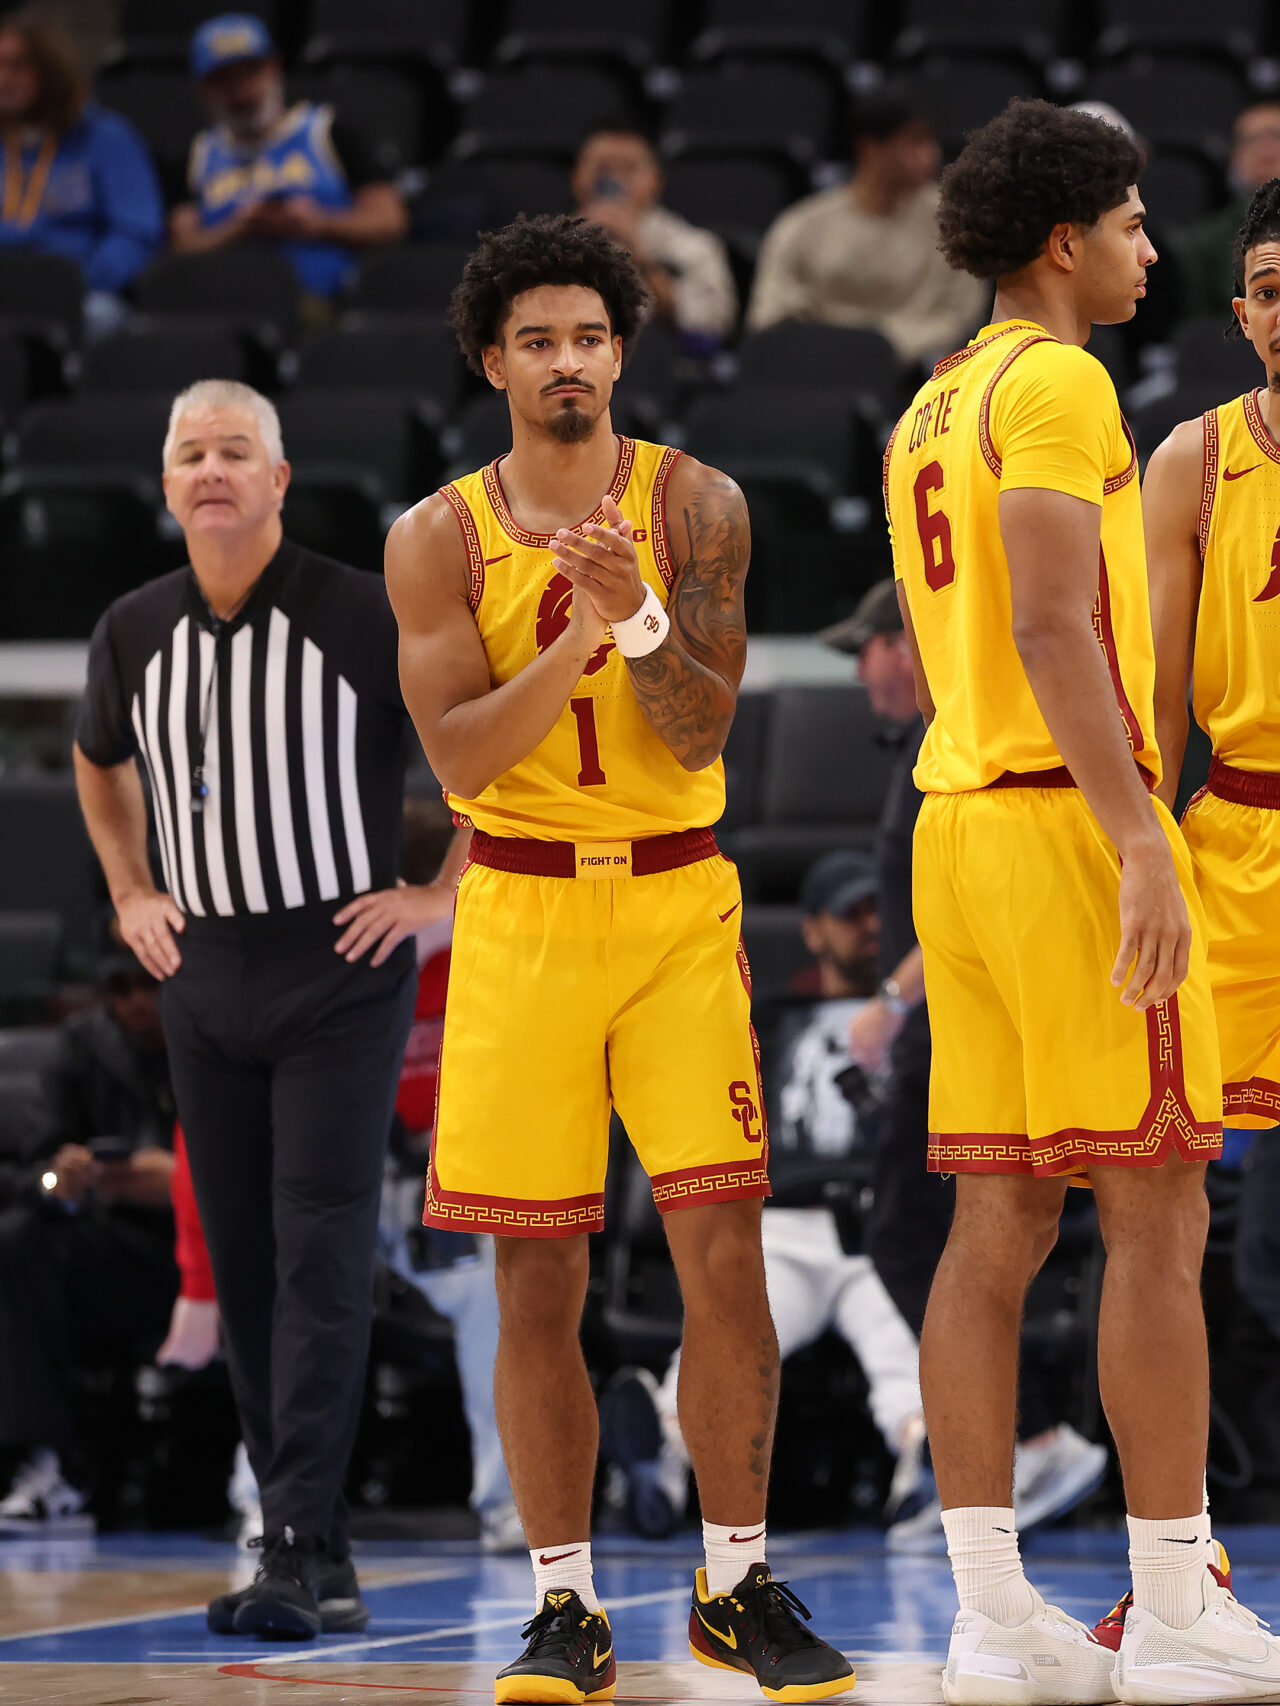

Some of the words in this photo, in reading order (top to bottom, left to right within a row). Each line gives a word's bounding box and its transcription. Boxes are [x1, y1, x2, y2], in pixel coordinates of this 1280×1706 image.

[909, 387, 959, 453] COFIE
[914, 460, 955, 592] 6
[570, 697, 606, 786] 1
[581, 857, 611, 866] FIGHT
[613, 856, 627, 864] ON
[729, 1081, 762, 1143] SC
